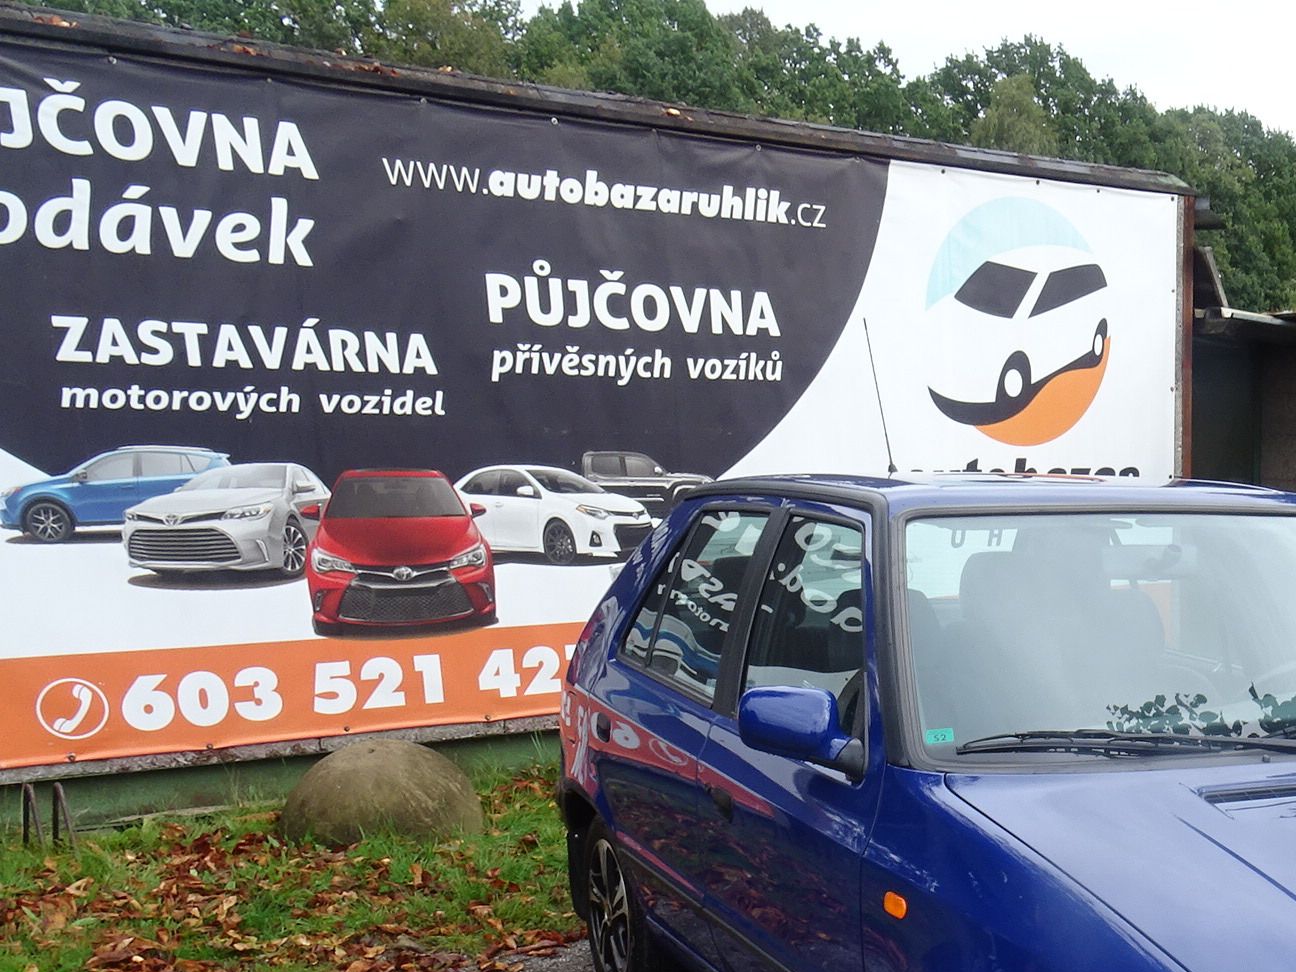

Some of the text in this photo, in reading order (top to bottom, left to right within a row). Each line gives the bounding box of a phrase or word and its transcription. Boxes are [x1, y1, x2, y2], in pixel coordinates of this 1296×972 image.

[381, 157, 828, 228] www.autobazaruhlik.cz
[484, 259, 782, 337] PŮJČOVNA
[50, 315, 439, 375] ZASTAVÁRNA
[490, 343, 783, 386] přívěsných vozíků
[60, 384, 446, 420] motorových vozidel
[121, 666, 283, 731] 603
[313, 653, 445, 715] 521
